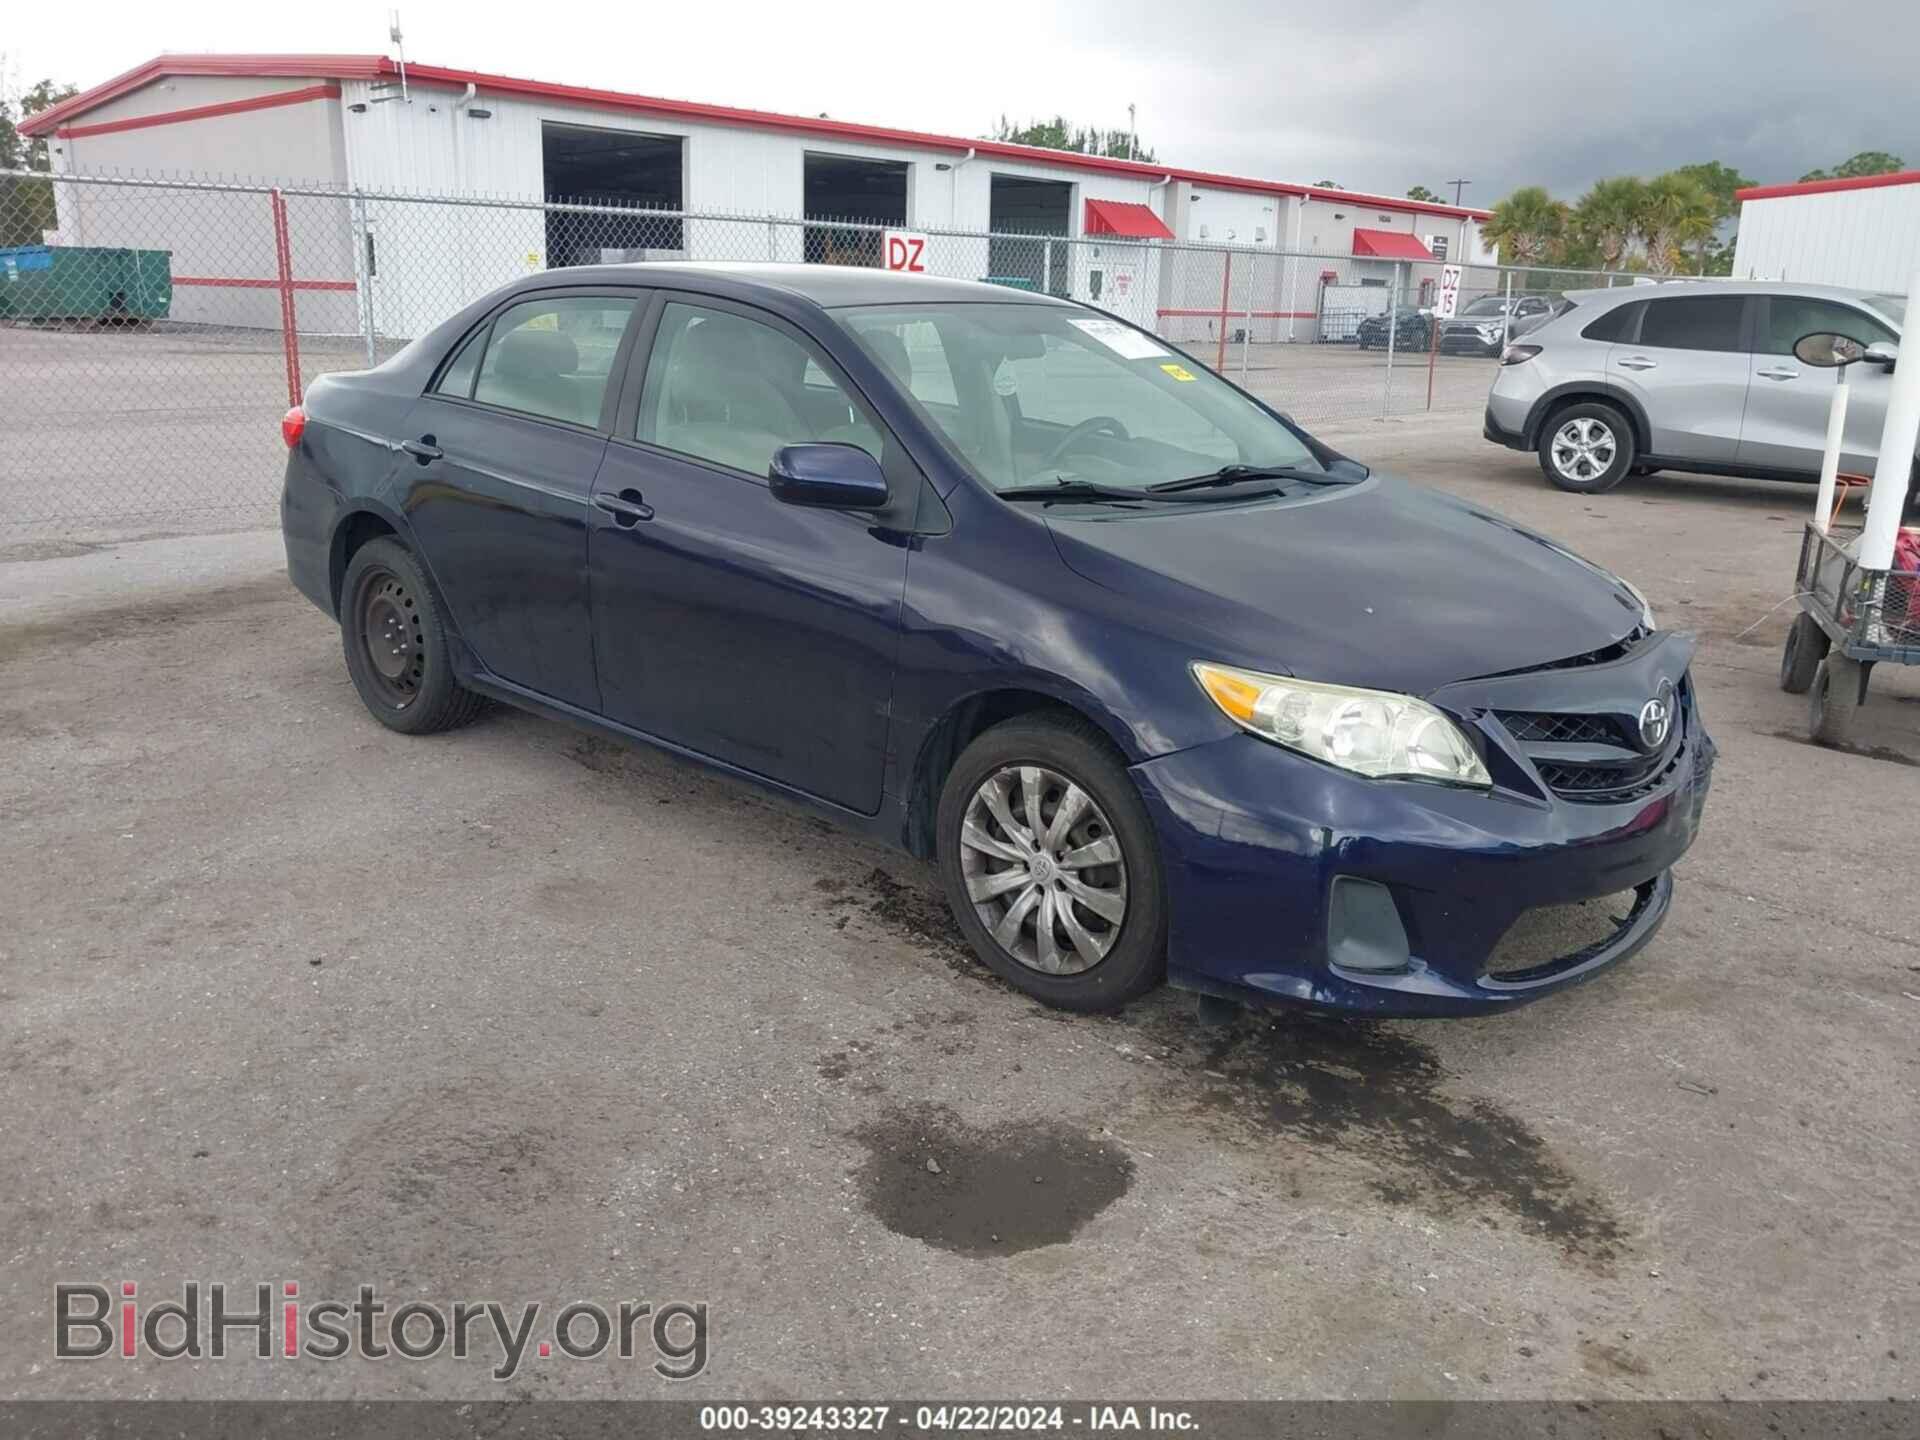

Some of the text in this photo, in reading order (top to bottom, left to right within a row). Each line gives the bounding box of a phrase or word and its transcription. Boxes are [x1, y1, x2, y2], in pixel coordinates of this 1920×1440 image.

[889, 237, 924, 272] DZ
[1443, 268, 1460, 291] DZ
[1442, 294, 1454, 314] 15
